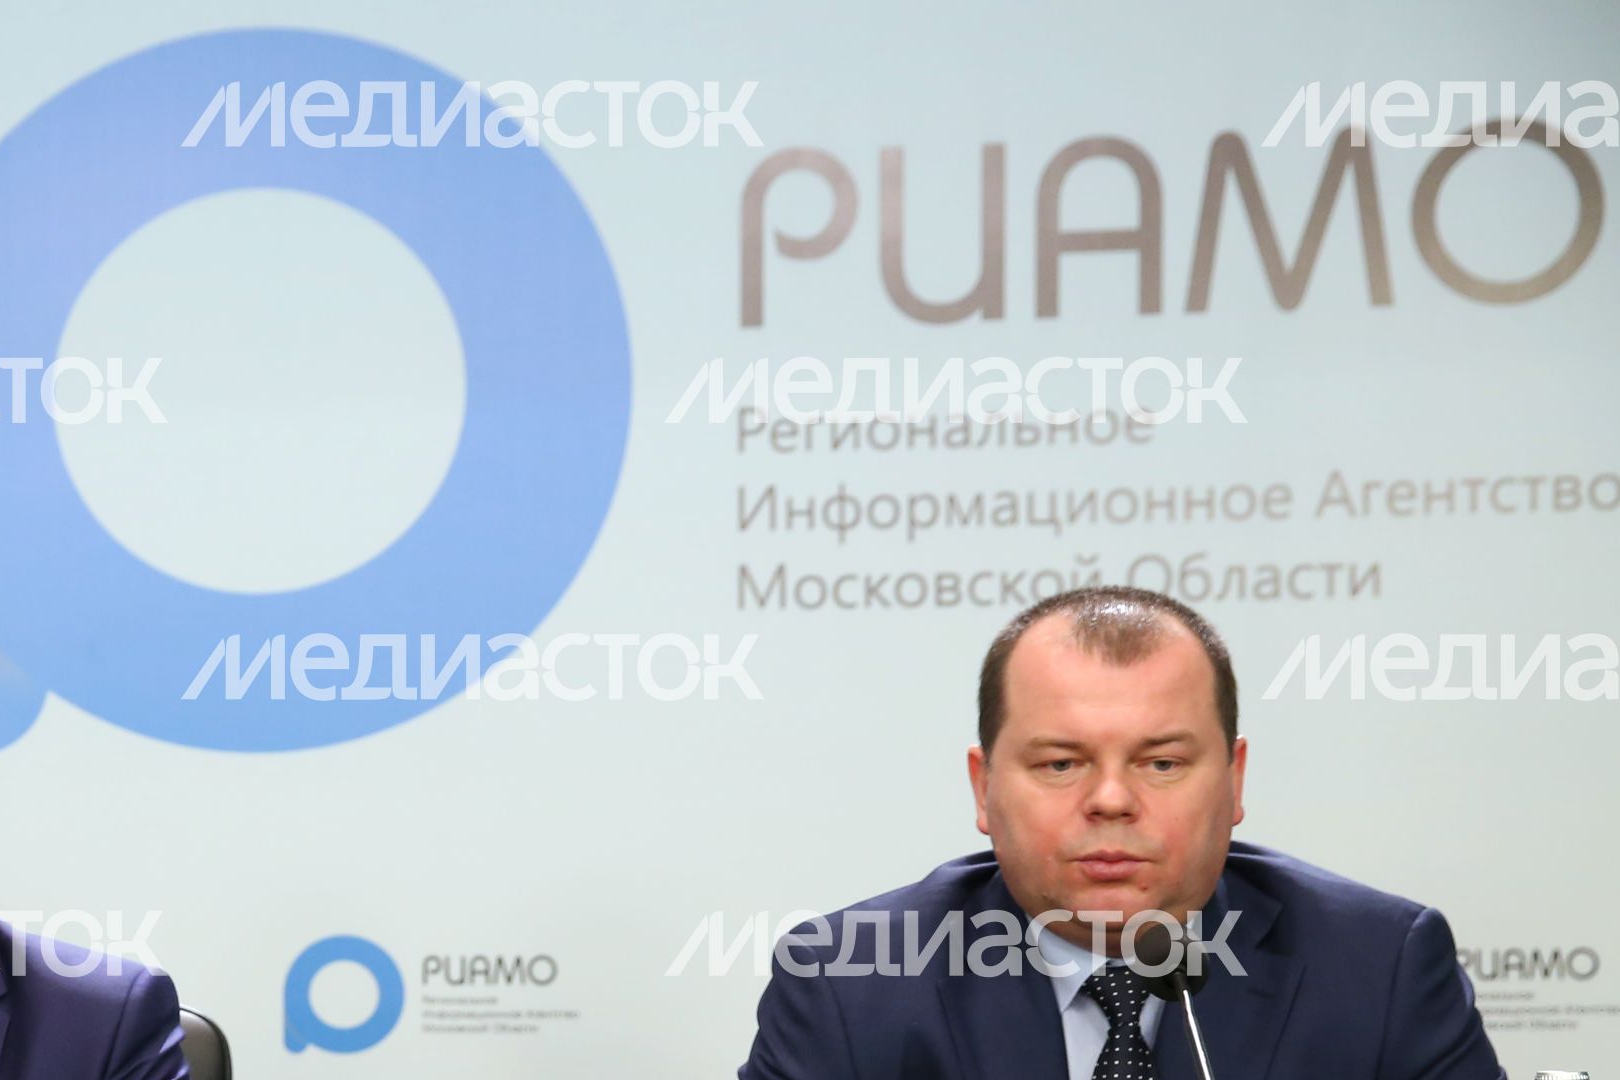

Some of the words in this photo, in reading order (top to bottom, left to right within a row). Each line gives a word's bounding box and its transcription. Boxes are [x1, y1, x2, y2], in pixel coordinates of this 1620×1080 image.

[738, 112, 1606, 328] РИАМО
[736, 403, 1156, 455] Региональное
[736, 476, 1294, 543] Информационное
[1314, 468, 1620, 519] Агентство
[736, 553, 1103, 612] Московской
[1126, 552, 1383, 601] Области
[421, 954, 559, 986] РИАМО
